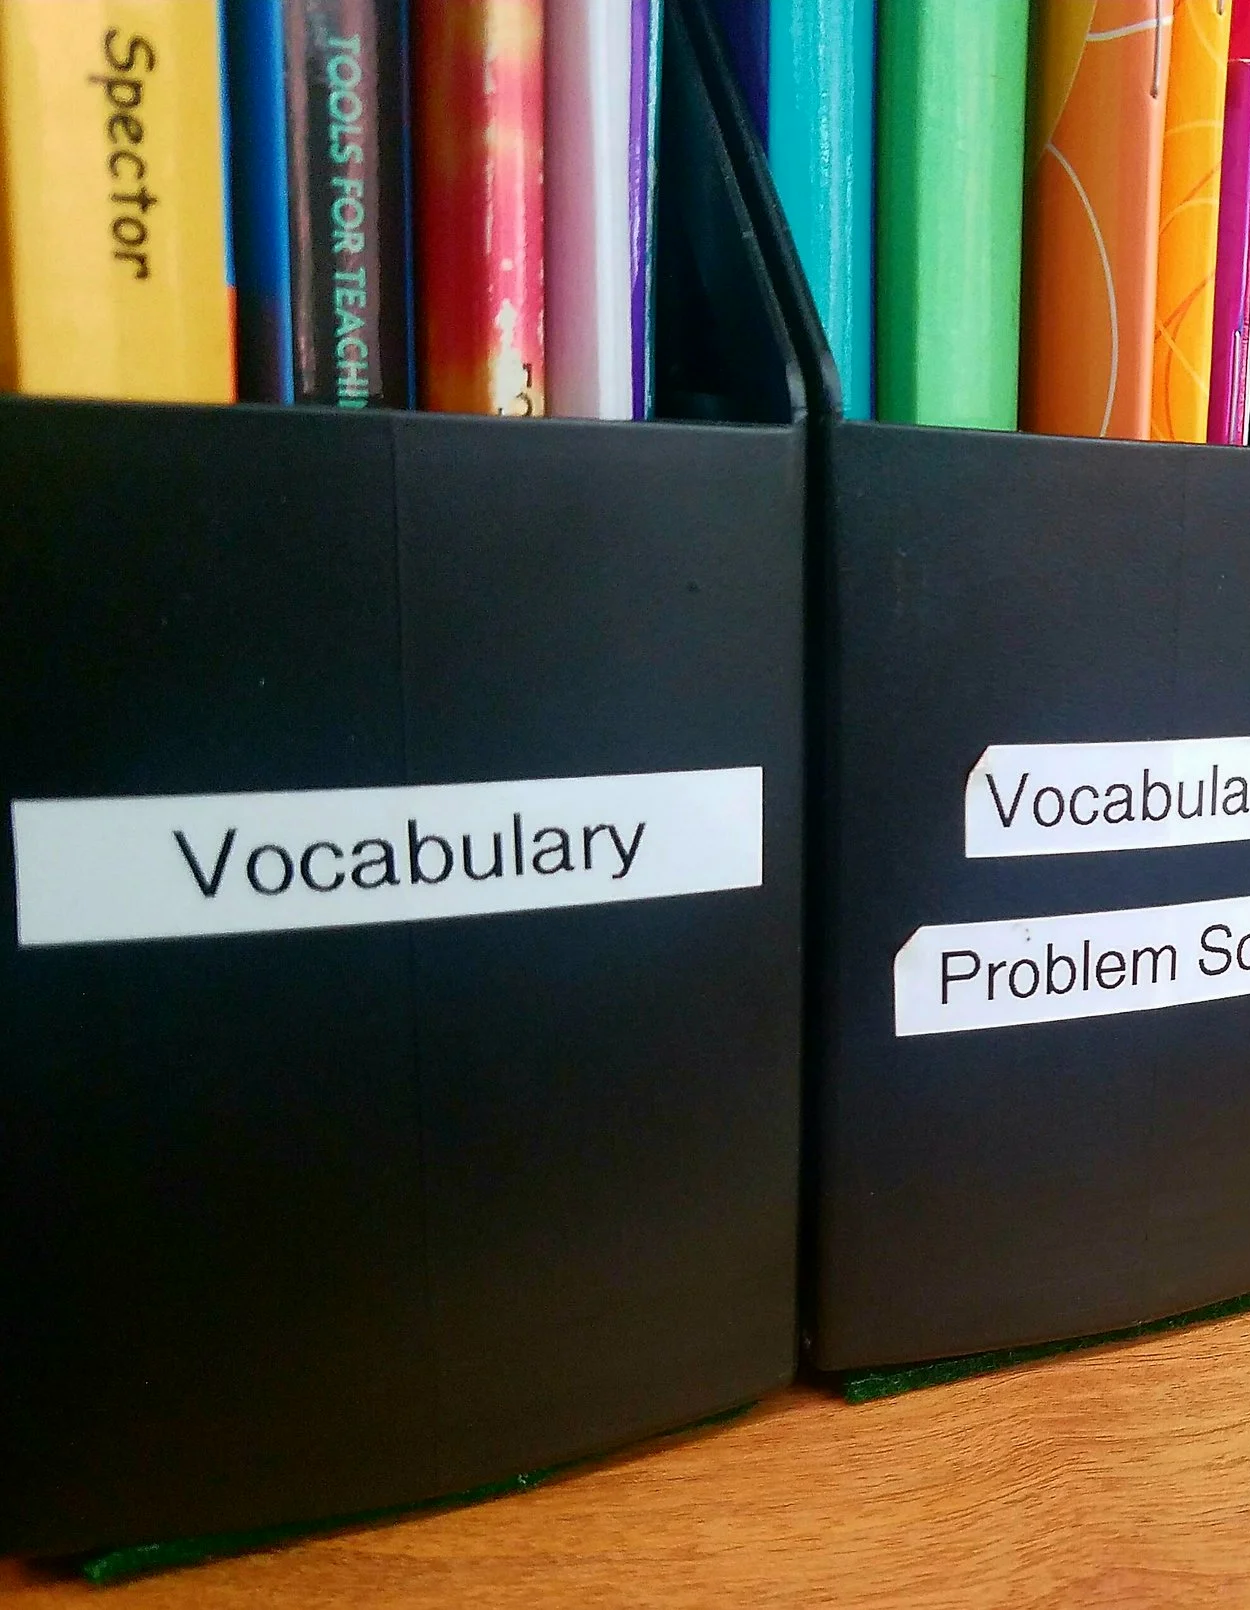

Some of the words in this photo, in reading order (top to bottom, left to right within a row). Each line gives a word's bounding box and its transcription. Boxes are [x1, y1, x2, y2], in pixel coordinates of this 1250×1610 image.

[326, 34, 365, 164] TOOLS
[86, 28, 157, 282] Spector
[330, 176, 366, 254] FOR
[172, 813, 647, 899] Vocabulary
[941, 939, 1177, 1005] Problem
